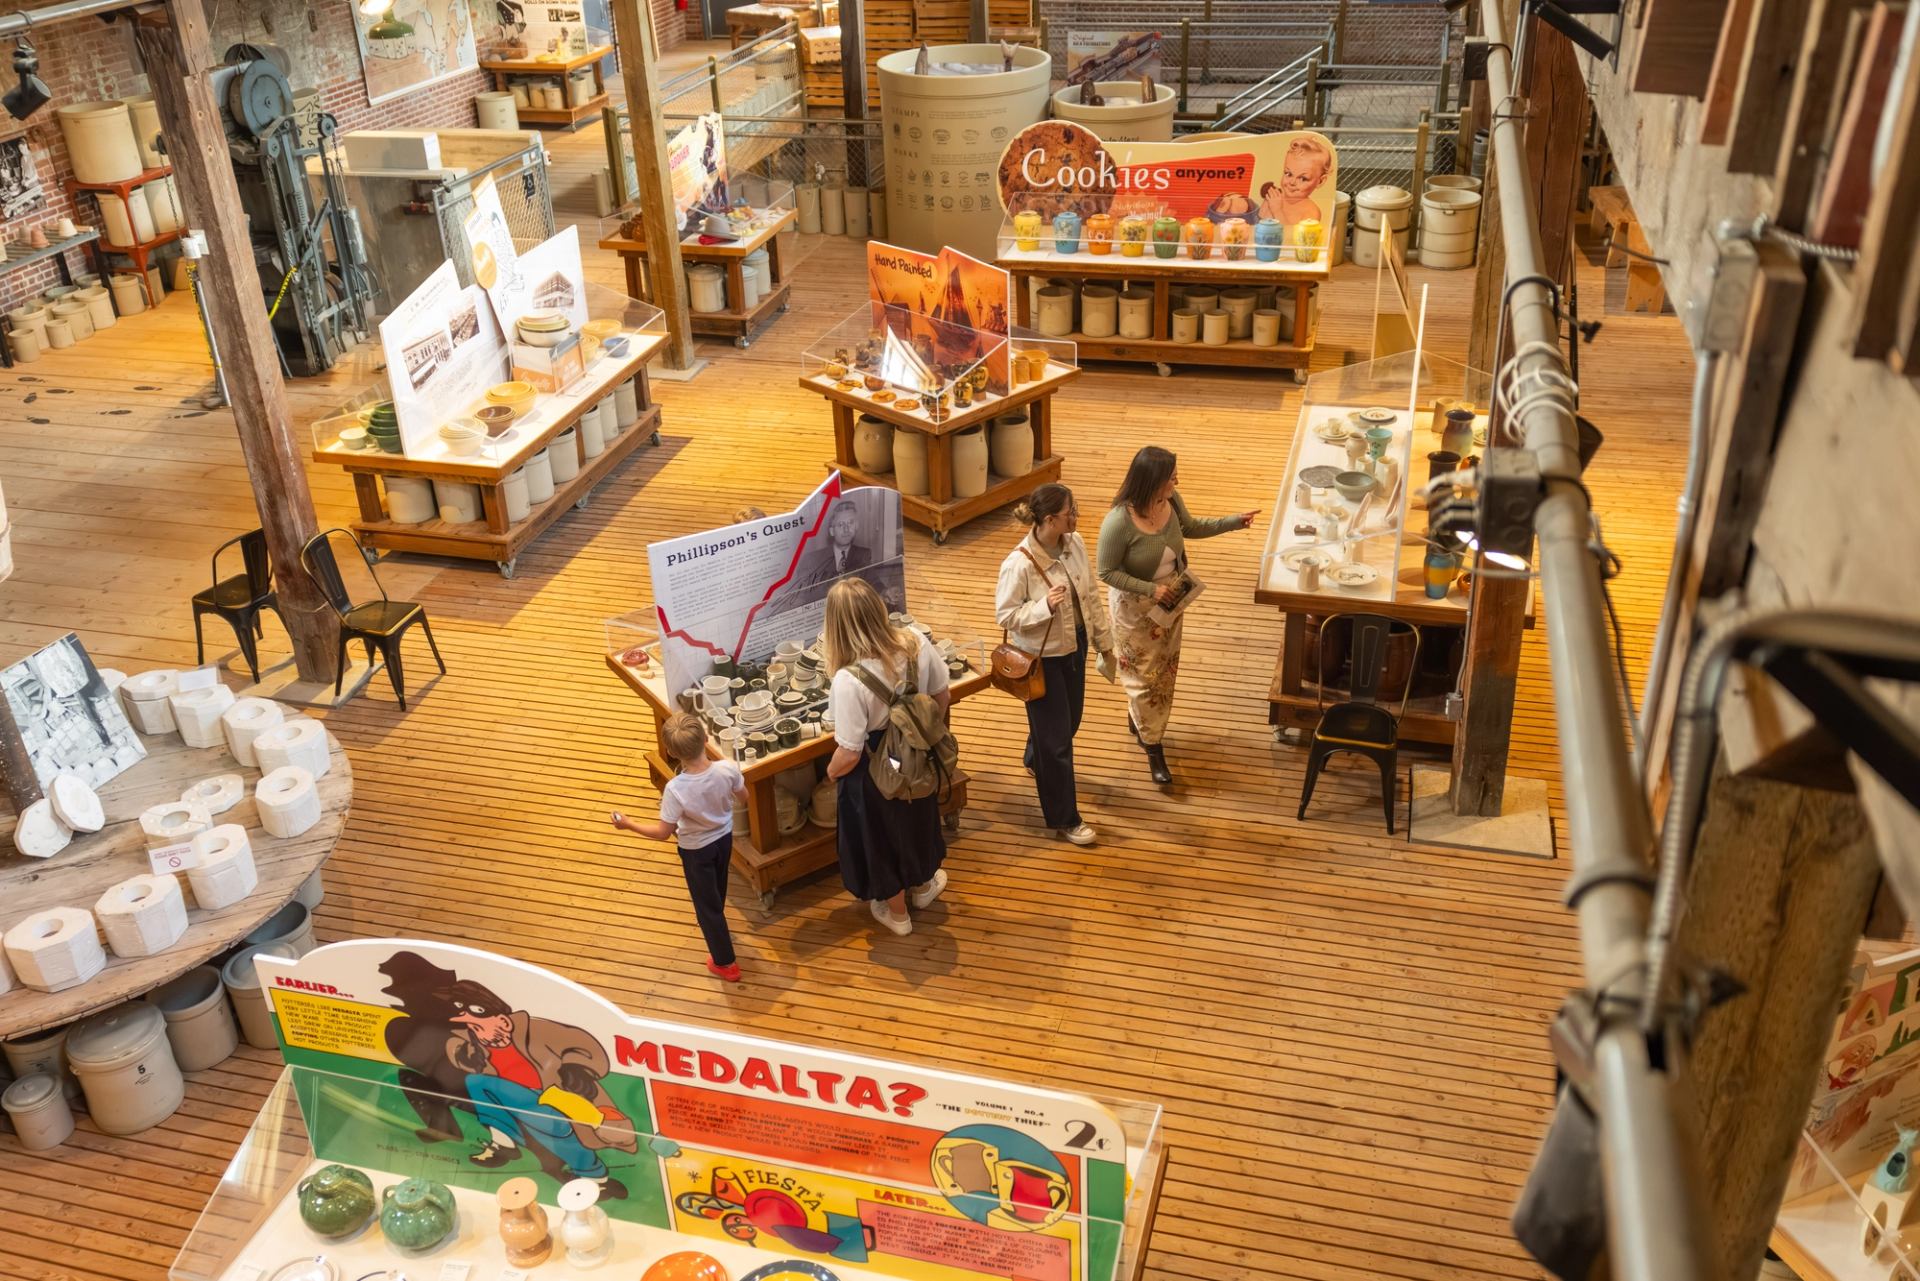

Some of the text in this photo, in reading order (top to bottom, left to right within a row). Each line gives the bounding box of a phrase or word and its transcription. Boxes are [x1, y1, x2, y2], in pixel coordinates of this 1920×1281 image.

[1022, 148, 1171, 190] Cookies
[1175, 166, 1246, 182] anyone?
[874, 253, 932, 279] Hand Painted
[666, 530, 758, 566] Phillipson's
[763, 516, 806, 537] Quest
[138, 1064, 146, 1074] 5
[614, 1035, 928, 1118] MEDALTA?
[976, 1100, 1008, 1110] VOLUME
[743, 1169, 822, 1212] FIESTA
